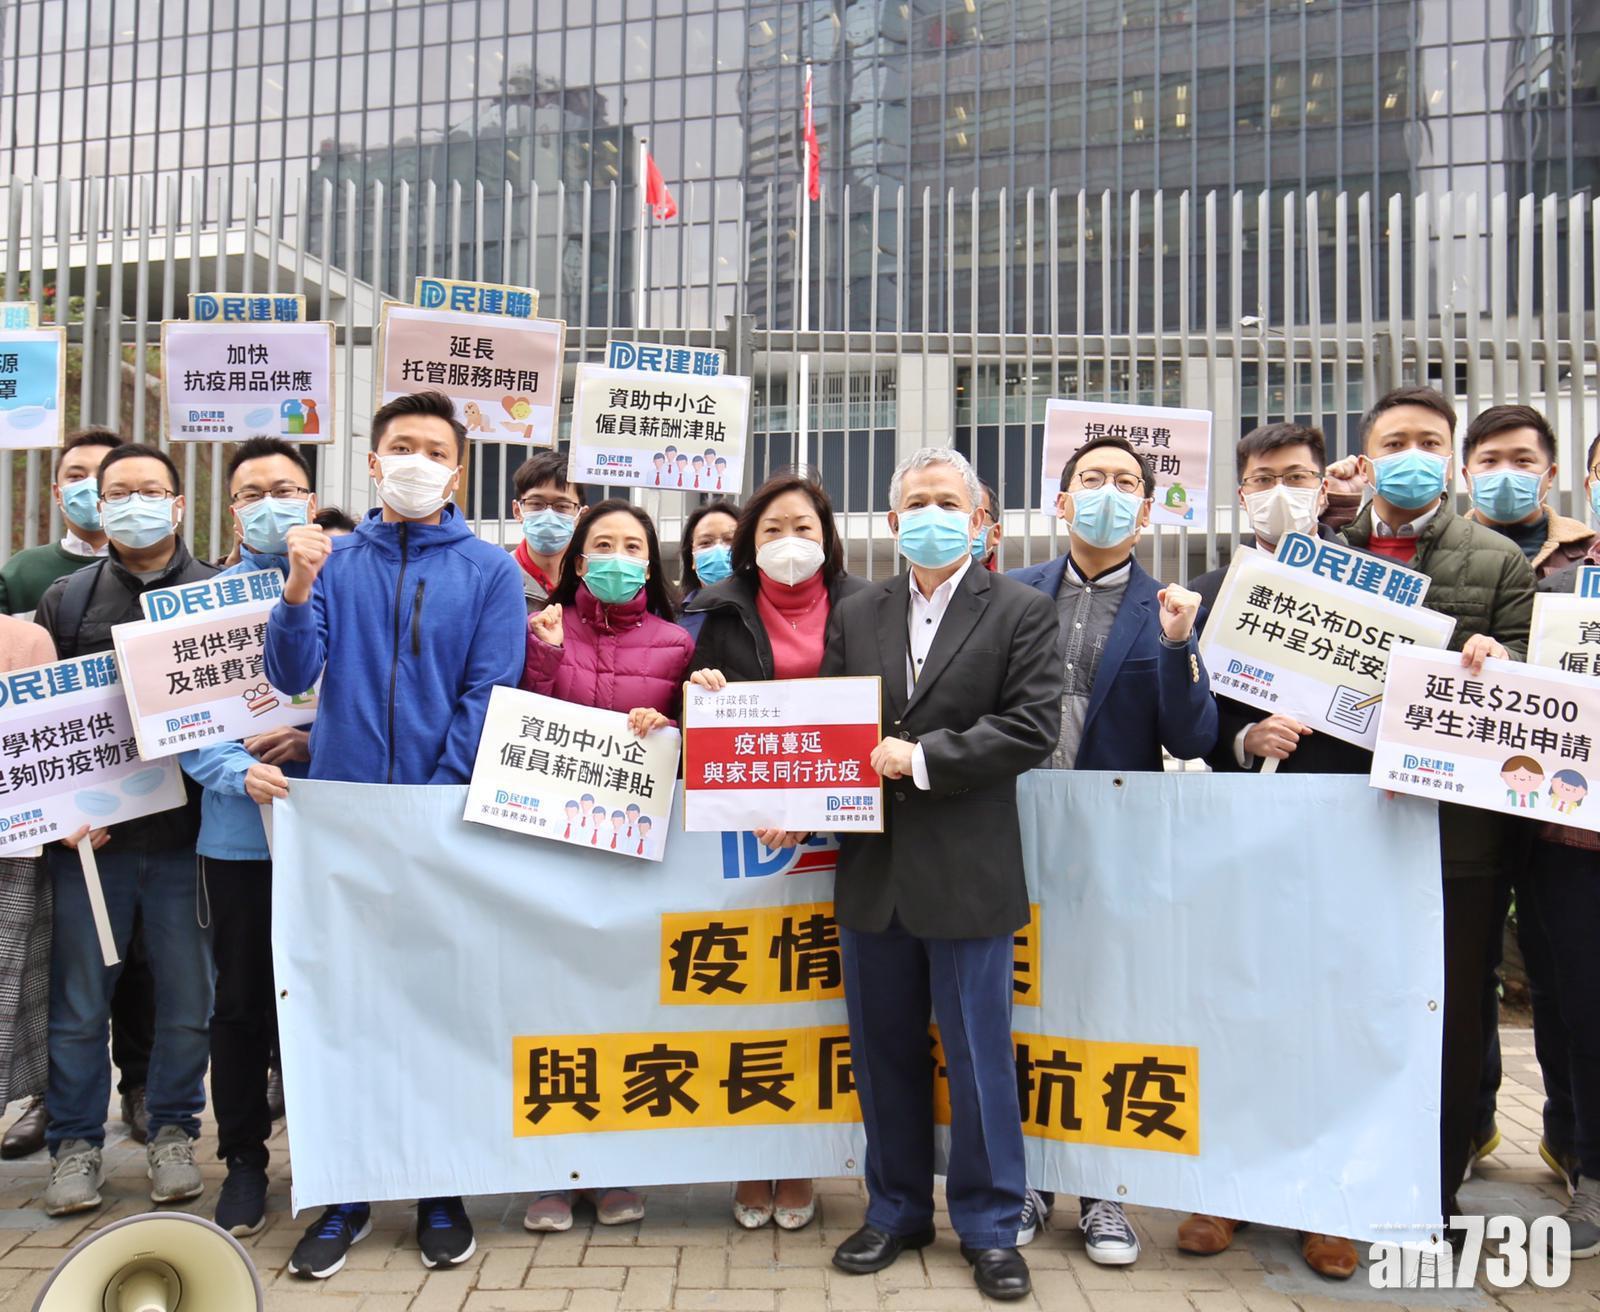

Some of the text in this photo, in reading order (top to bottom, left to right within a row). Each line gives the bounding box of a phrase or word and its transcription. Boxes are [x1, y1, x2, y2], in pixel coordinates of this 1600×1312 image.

[223, 297, 299, 321] 民建聯
[451, 286, 532, 318] 民建聯
[227, 344, 269, 365] 加快
[450, 335, 495, 361] 延長
[637, 347, 720, 377] 民建聯
[184, 371, 312, 392] 抗疫用品供應
[402, 358, 539, 392] 托管服務時間
[609, 387, 717, 415] 資助中小企
[596, 413, 727, 442] 僱員薪酬津貼
[1085, 422, 1171, 449] 提供學費
[1312, 544, 1424, 607] 民建聯
[180, 571, 282, 615] 民建聯
[1247, 584, 1416, 652] 盡快公布DSE
[1235, 610, 1387, 684] 升中呈分試安
[8, 654, 119, 705] 民建聯
[1559, 651, 1600, 677] 僱
[1424, 673, 1579, 723] 延長$2500
[2, 711, 116, 759] 學校提供
[521, 715, 647, 766] 資助中小企
[734, 731, 823, 755] 疫情蔓延
[1404, 703, 1592, 763] 學生津貼申請
[500, 742, 655, 799] 僱員薪酬津貼
[703, 759, 861, 784] 與家長同行抗疫
[523, 1037, 1189, 1143] 與家長同抗疫
